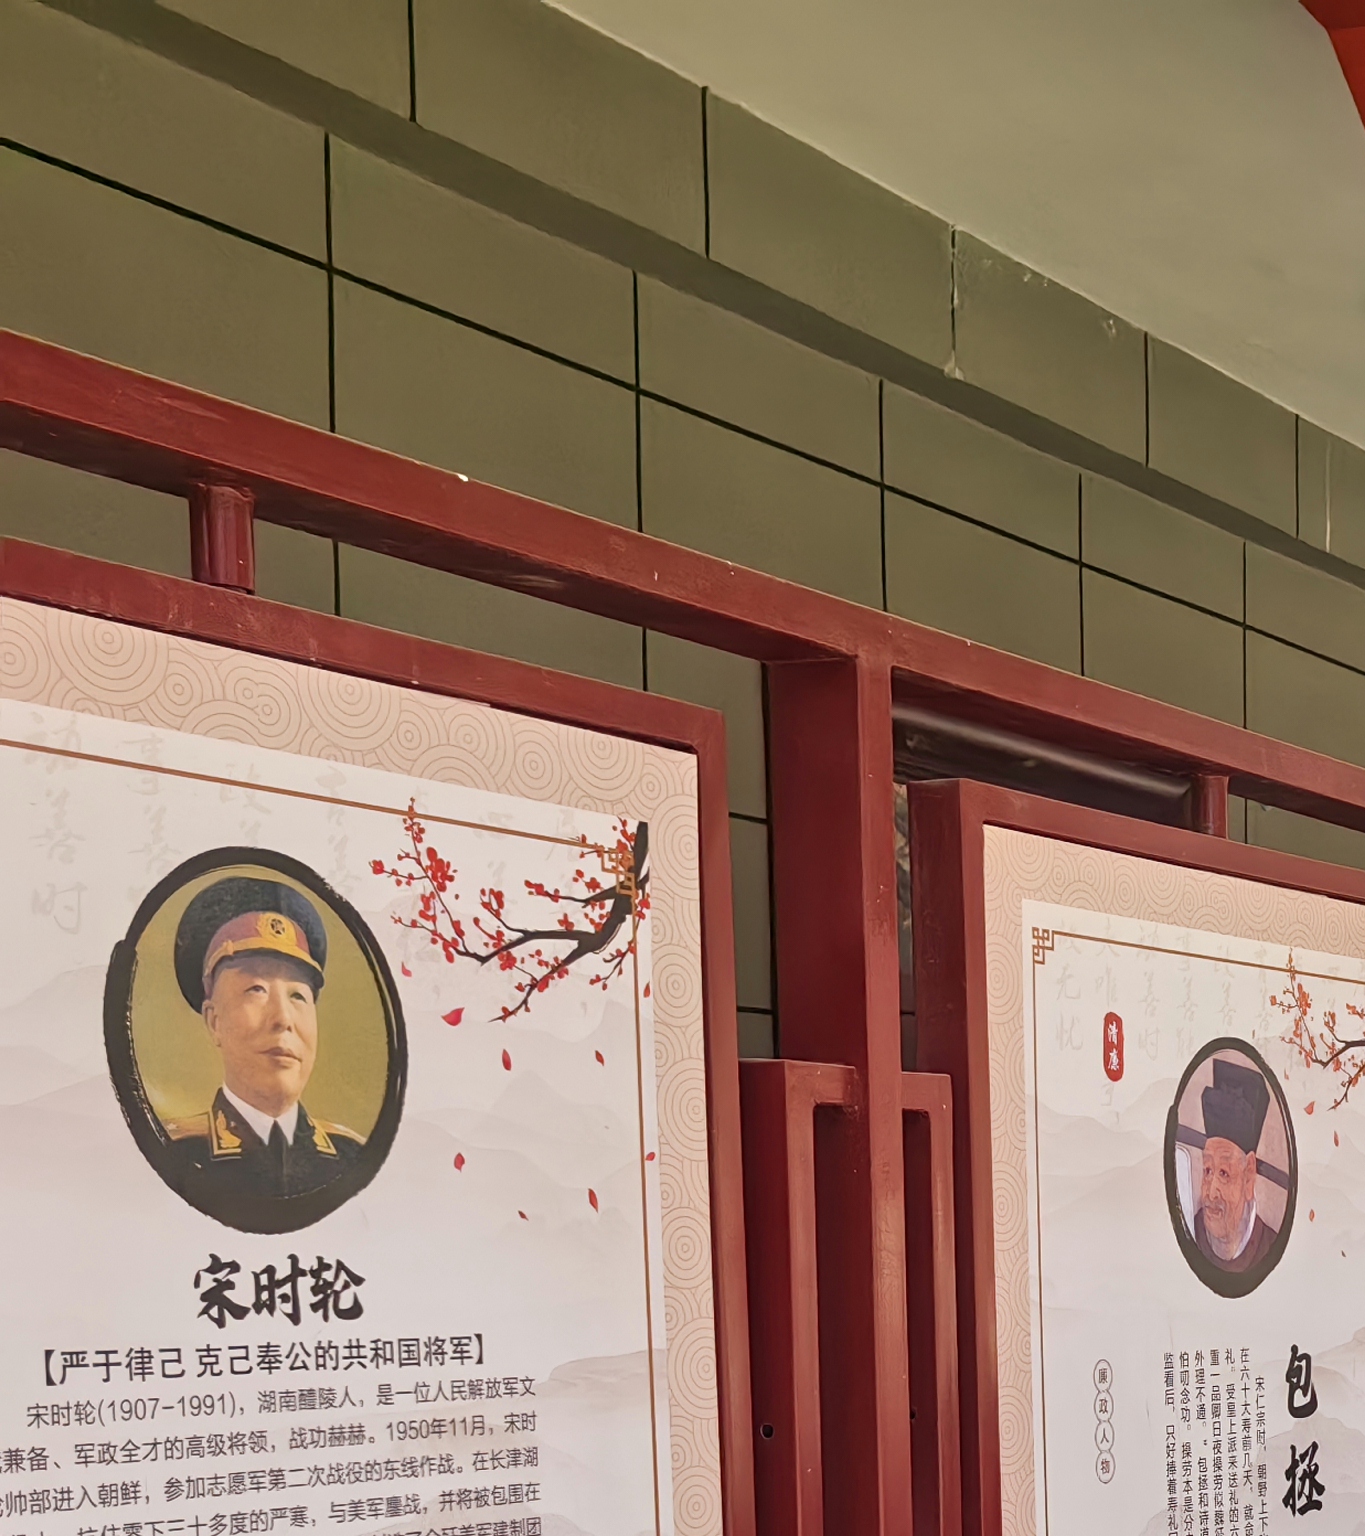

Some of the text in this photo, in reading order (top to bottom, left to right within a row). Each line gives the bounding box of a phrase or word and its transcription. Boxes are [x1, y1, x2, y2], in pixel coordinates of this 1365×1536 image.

[194, 1253, 367, 1329] 宋时轮
[0, 1410, 538, 1475] 兼备、军政全才的高级将领，战功赫赫。1950年11月，宋时
[1282, 1345, 1325, 1517] 包拯
[0, 1446, 539, 1518] 帅部进入朝鲜，参加志愿军第二次战役的东线作战。在长津湖
